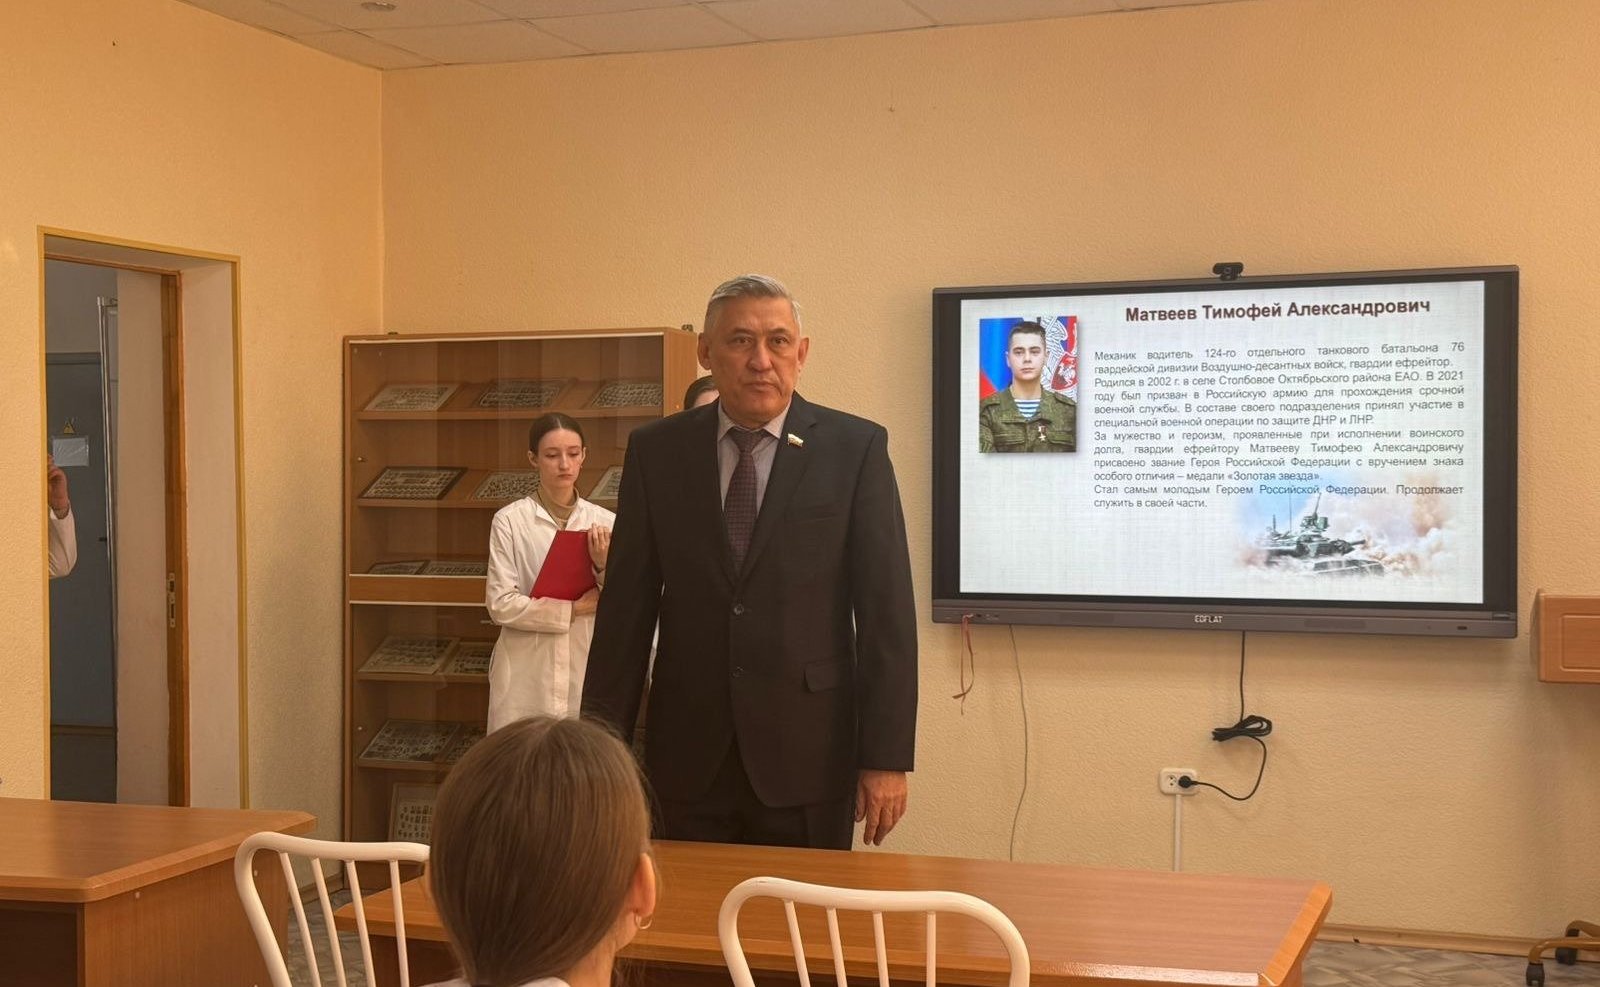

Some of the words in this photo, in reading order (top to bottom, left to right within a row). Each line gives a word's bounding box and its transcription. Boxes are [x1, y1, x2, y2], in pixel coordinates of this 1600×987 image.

[1126, 307, 1197, 322] Матвеев
[1202, 303, 1281, 321] Тимофей
[1287, 301, 1430, 317] Александрович
[1095, 352, 1136, 360] Механик
[1148, 351, 1193, 360] водитель
[1205, 349, 1236, 358] 124-го
[1247, 348, 1305, 358] отдельного
[1318, 347, 1369, 355] танкового
[1381, 344, 1438, 354] батальона
[1451, 342, 1465, 352] 76
[1095, 363, 1155, 375] гвардейской
[1157, 365, 1198, 374] дивизии
[1201, 361, 1311, 373] Воздушно-десантных
[1350, 359, 1392, 368] гвардии
[1395, 358, 1453, 368] ефрейтор.
[1095, 378, 1135, 387] Родился
[1148, 377, 1171, 386] 2002
[1219, 375, 1274, 385] Столбовое
[1278, 372, 1349, 385] Октябрьского
[1352, 373, 1391, 384] района
[1395, 372, 1423, 381] ЕАО.
[1427, 371, 1433, 380] В
[1438, 371, 1464, 380] 2021
[1095, 393, 1115, 402] году
[1121, 391, 1140, 400] был
[1148, 391, 1187, 401] призван
[1206, 389, 1266, 400] Российскую
[1273, 390, 1308, 399] армию
[1314, 388, 1333, 397] для
[1341, 387, 1412, 397] прохождения
[1419, 385, 1464, 396] срочной
[1095, 405, 1134, 414] военной
[1139, 403, 1180, 416] службы.
[1185, 404, 1192, 412] В
[1280, 403, 1360, 412] подразделения
[1365, 402, 1404, 411] принял
[1409, 401, 1452, 410] участие
[1095, 418, 1158, 429] специальной
[1161, 417, 1202, 427] военной
[1205, 417, 1253, 427] операции
[1257, 417, 1268, 426] по
[1272, 417, 1310, 426] защите
[1313, 415, 1336, 426] ДНР
[1095, 432, 1106, 441] За
[1114, 432, 1161, 442] мужество
[1182, 432, 1225, 442] героизм,
[1233, 431, 1302, 441] проявленные
[1311, 430, 1329, 440] при
[1338, 430, 1401, 440] исполнении
[1409, 429, 1464, 438] воинского
[1094, 447, 1124, 456] долга,
[1134, 446, 1174, 455] гвардии
[1184, 444, 1239, 455] ефрейтору
[1251, 444, 1300, 454] Матвееву
[1311, 443, 1362, 453] Тимофею
[1373, 443, 1464, 454] Александровичу
[1094, 460, 1145, 469] присвоено
[1191, 458, 1220, 468] Героя
[1226, 457, 1285, 467] Российской
[1291, 458, 1350, 468] Федерации
[1368, 458, 1426, 468] вручением
[1433, 458, 1464, 466] знака
[1094, 472, 1133, 482] особого
[1135, 472, 1175, 480] отличия
[1187, 473, 1224, 481] медали
[1228, 471, 1276, 480] «Золотая
[1094, 485, 1118, 494] Стал
[1124, 486, 1157, 494] самым
[1164, 486, 1210, 495] молодым
[1216, 485, 1253, 496] Героем
[1260, 485, 1320, 495] Российской
[1396, 485, 1463, 495] Продолжает
[1094, 500, 1134, 509] служить
[1145, 498, 1174, 507] своей
